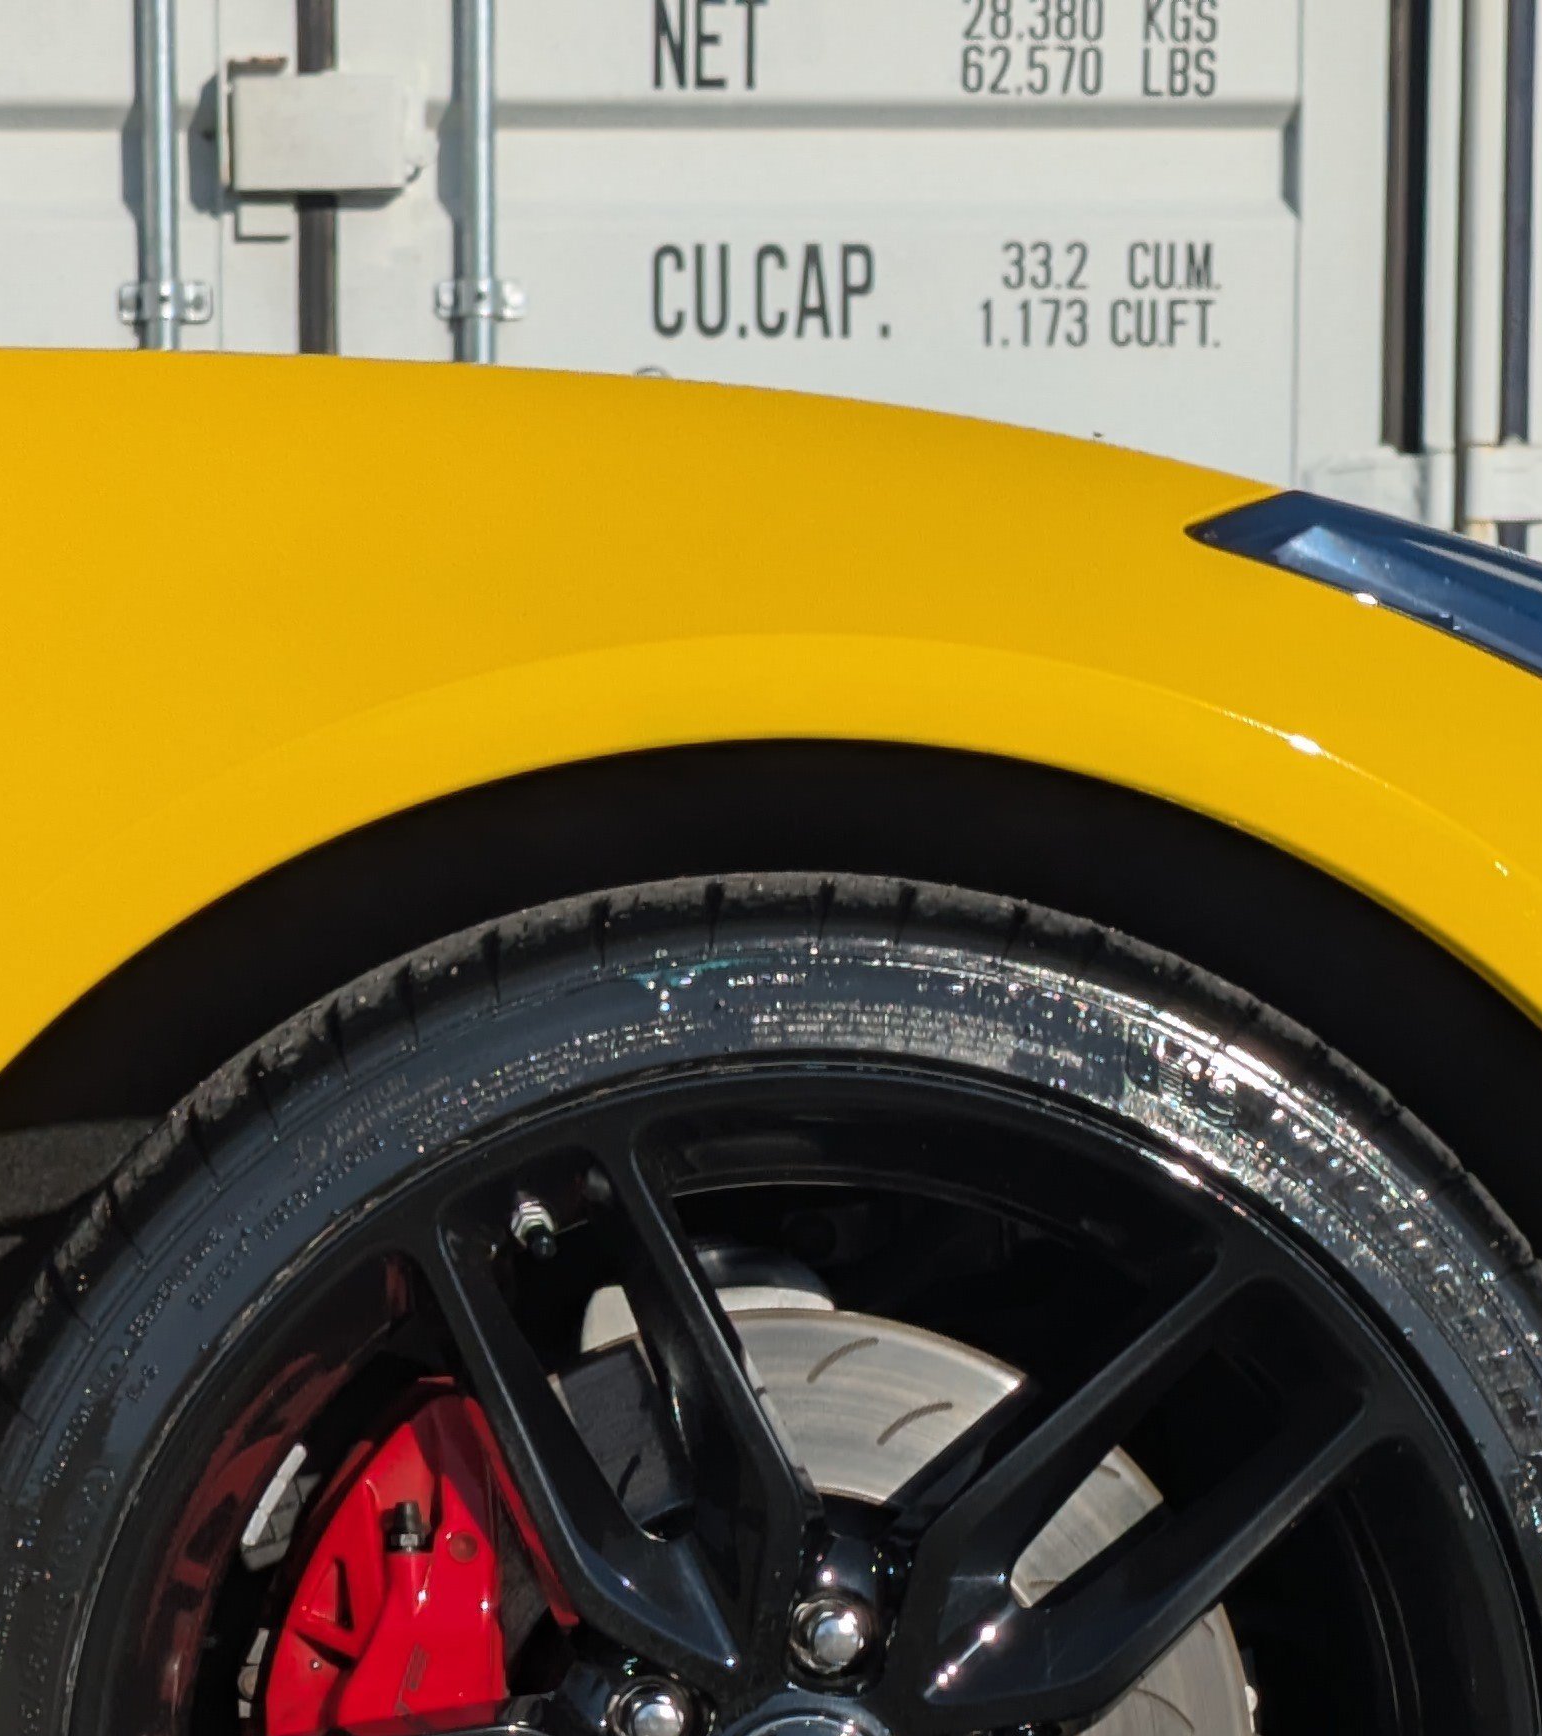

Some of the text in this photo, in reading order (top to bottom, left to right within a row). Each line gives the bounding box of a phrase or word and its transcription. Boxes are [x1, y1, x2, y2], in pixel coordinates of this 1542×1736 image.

[652, 0, 768, 90] NET
[961, 0, 1219, 43] 28.380 KGS
[960, 47, 1218, 97] 62.570 LBS
[652, 243, 891, 339] CU.CAP.
[1001, 242, 1220, 291] 33.2 CU.M.
[980, 299, 1221, 348] 1.173 CU.FT.
